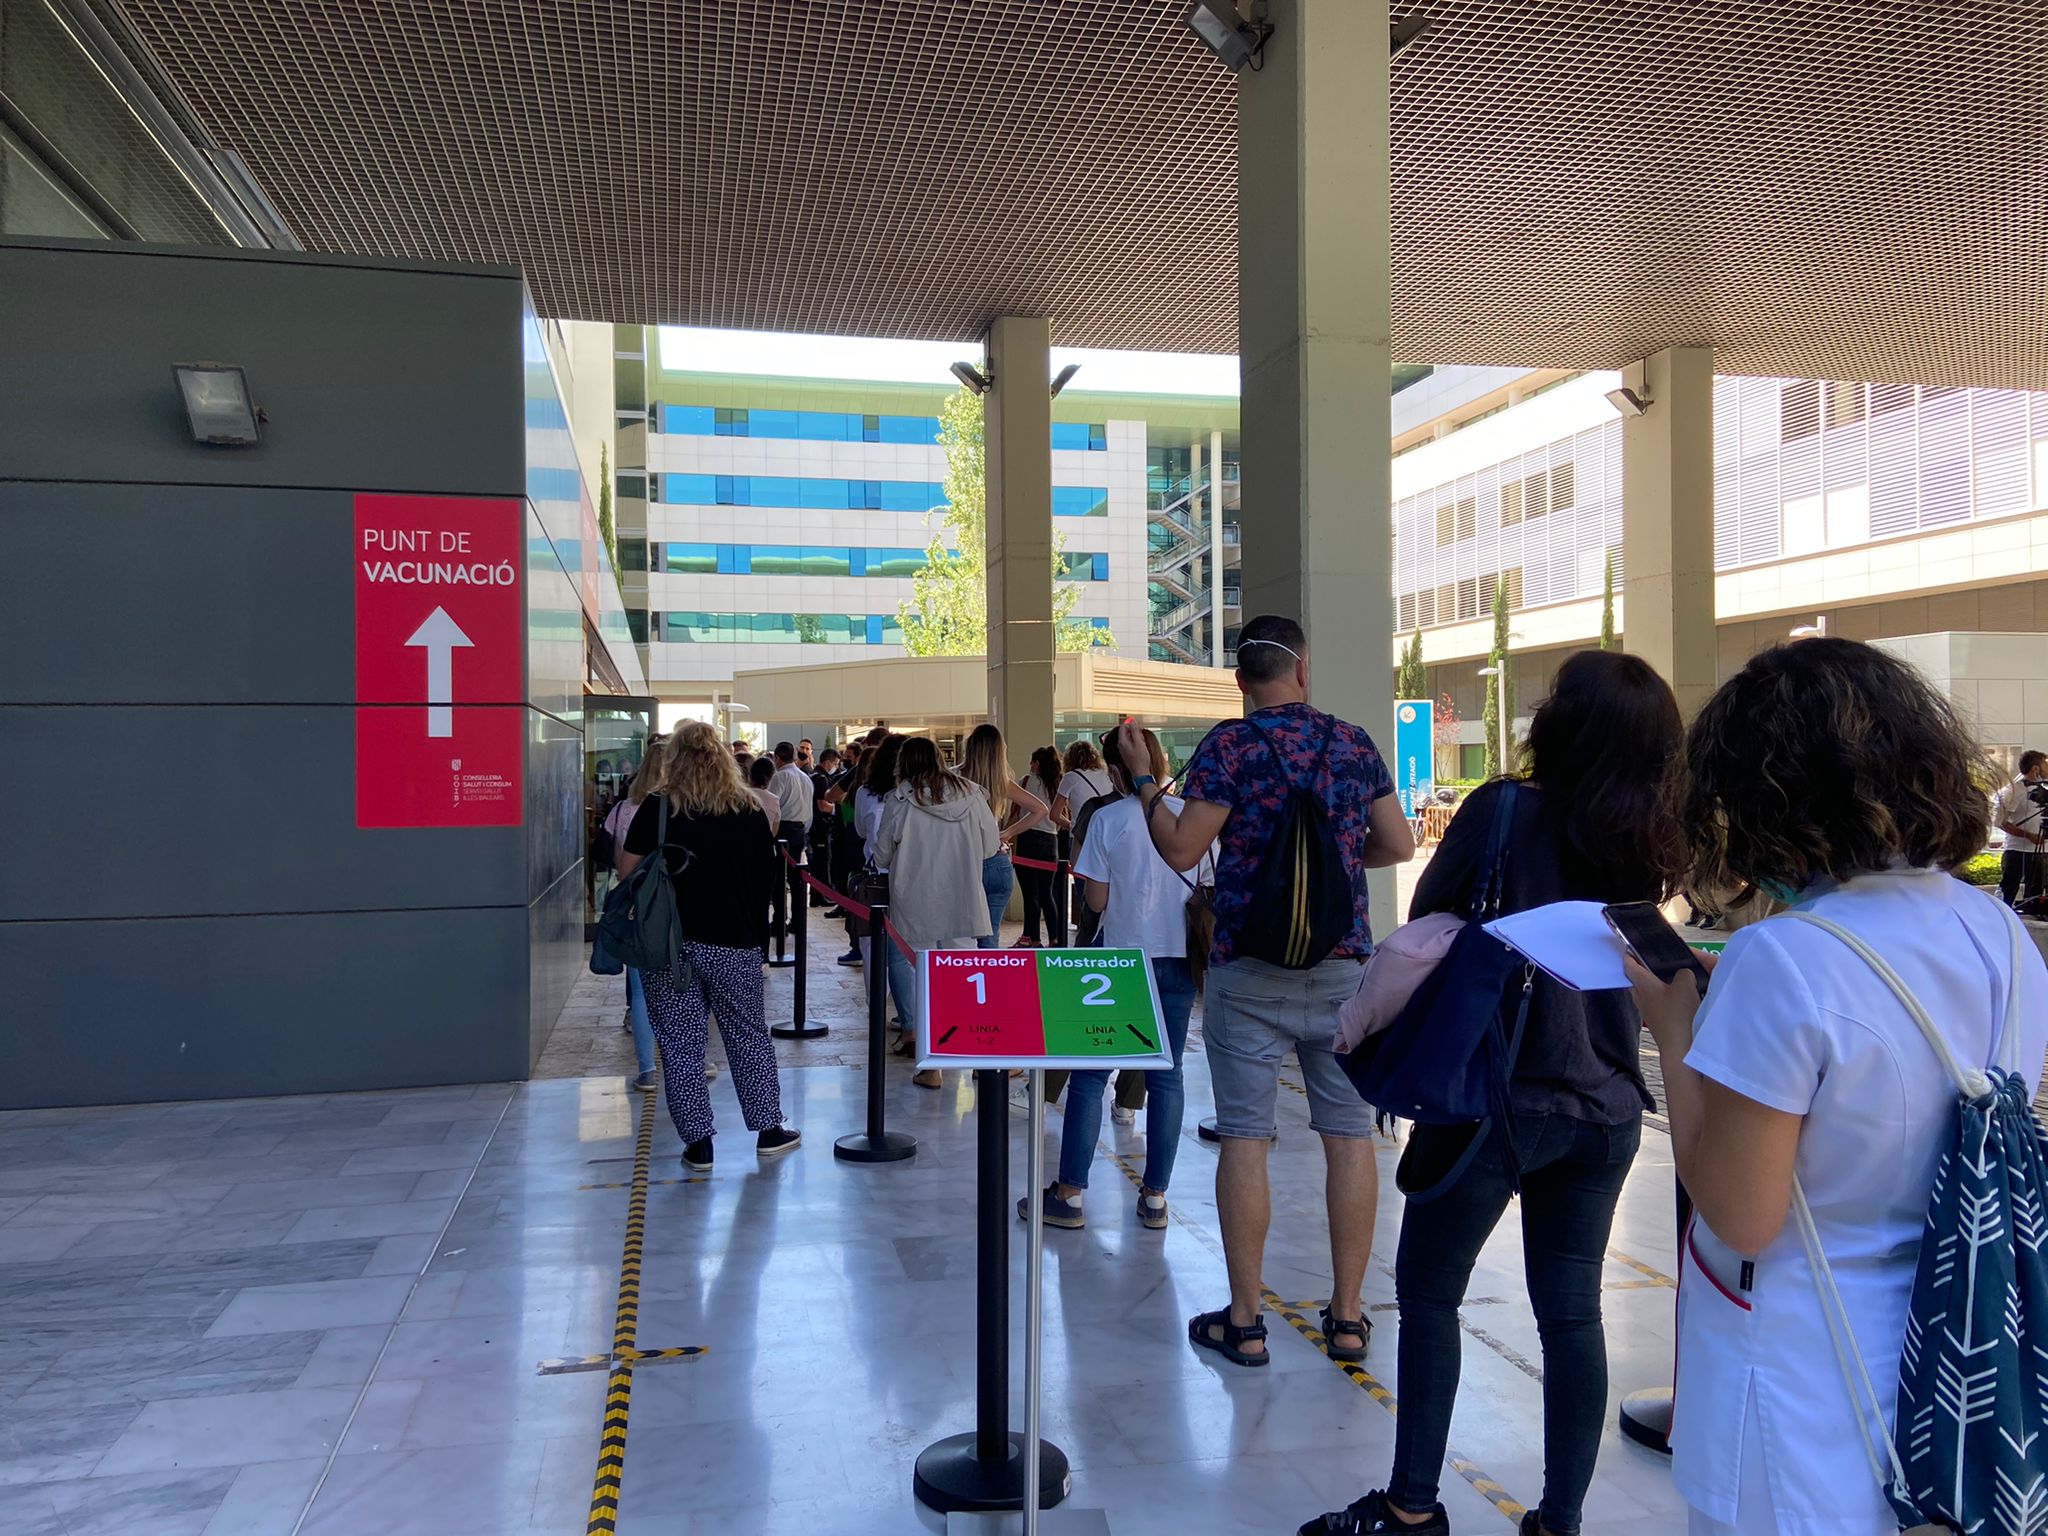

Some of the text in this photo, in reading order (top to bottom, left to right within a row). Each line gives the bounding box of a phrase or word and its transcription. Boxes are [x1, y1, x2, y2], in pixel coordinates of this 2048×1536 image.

[364, 528, 471, 553] PUNT DE
[363, 558, 515, 586] VACUNACIÓ
[935, 954, 1028, 967] Mostrador
[1045, 955, 1137, 968] Mostrador
[966, 971, 987, 1005] 1
[1080, 973, 1116, 1006] 2
[968, 1022, 1001, 1034] LÍNIA
[1085, 1023, 1117, 1035] LÍNIA
[1092, 1037, 1114, 1047] 3-4
